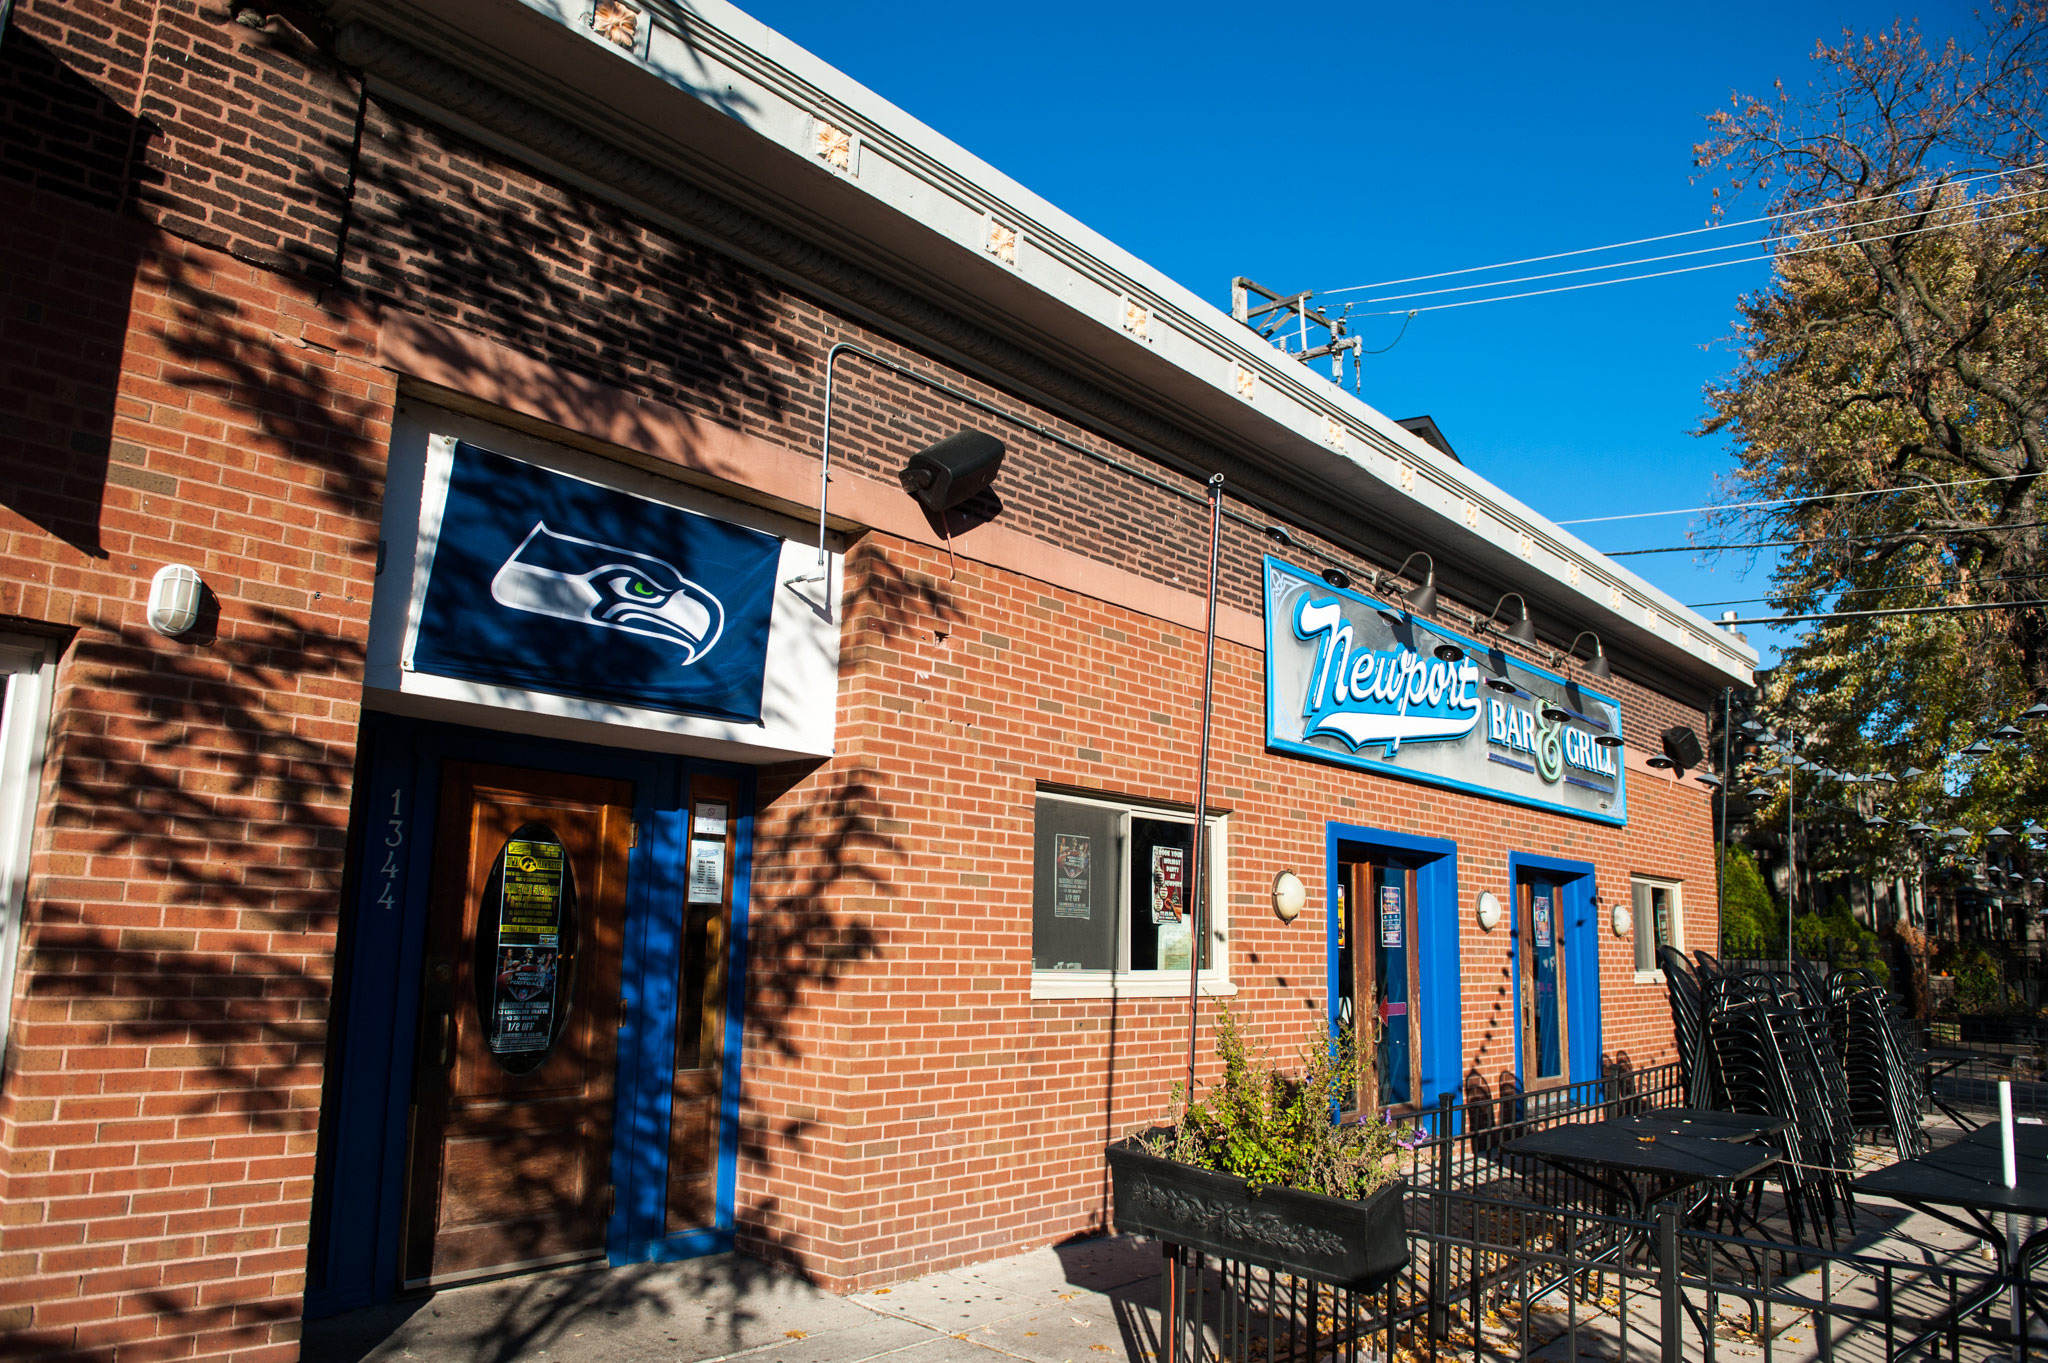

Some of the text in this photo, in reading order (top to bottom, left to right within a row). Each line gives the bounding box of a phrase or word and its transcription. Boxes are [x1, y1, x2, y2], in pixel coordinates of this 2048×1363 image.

[1294, 594, 1482, 756] Newport
[1487, 698, 1617, 783] BAR & GRILL
[376, 788, 404, 911] 1344
[507, 1022, 536, 1032] 1/2 OFF
